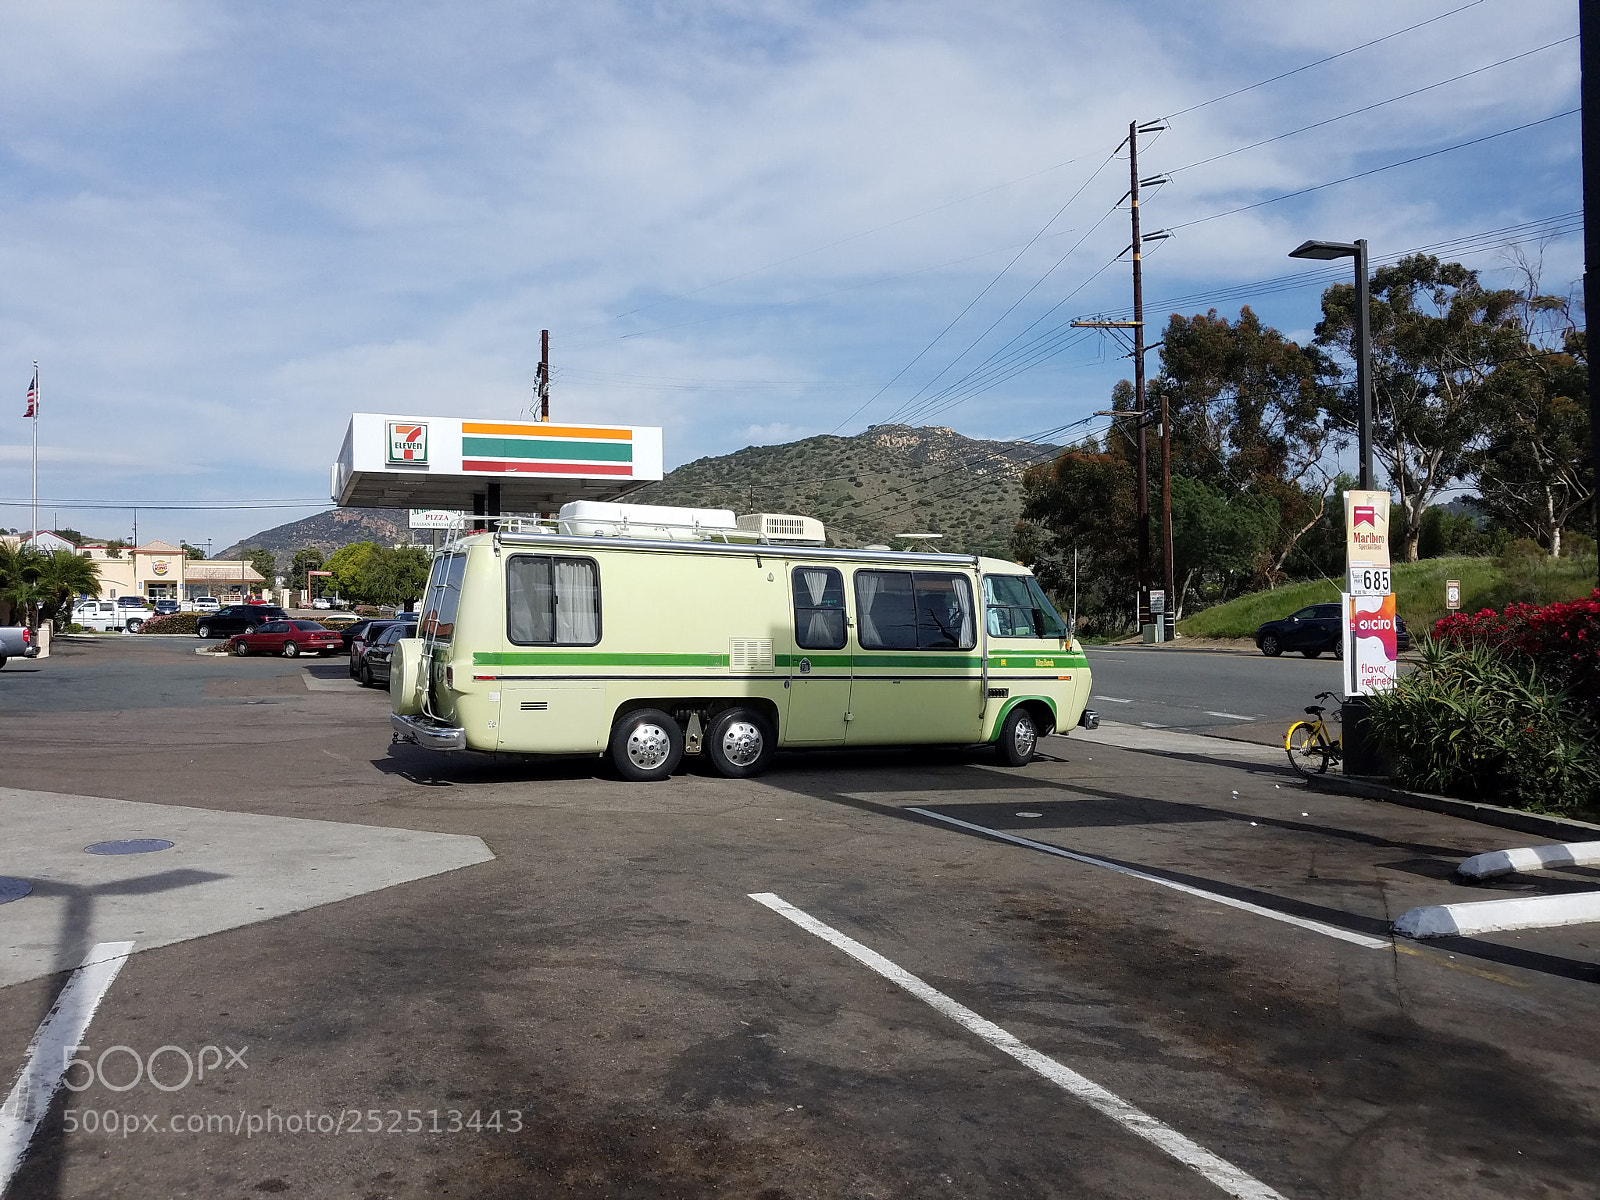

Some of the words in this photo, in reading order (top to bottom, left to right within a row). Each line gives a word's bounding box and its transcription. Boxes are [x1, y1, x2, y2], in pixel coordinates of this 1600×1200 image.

[1353, 532, 1385, 544] Marlboro
[1363, 570, 1389, 590] 685
[1361, 663, 1387, 674] flavor
[1362, 675, 1392, 686] refined
